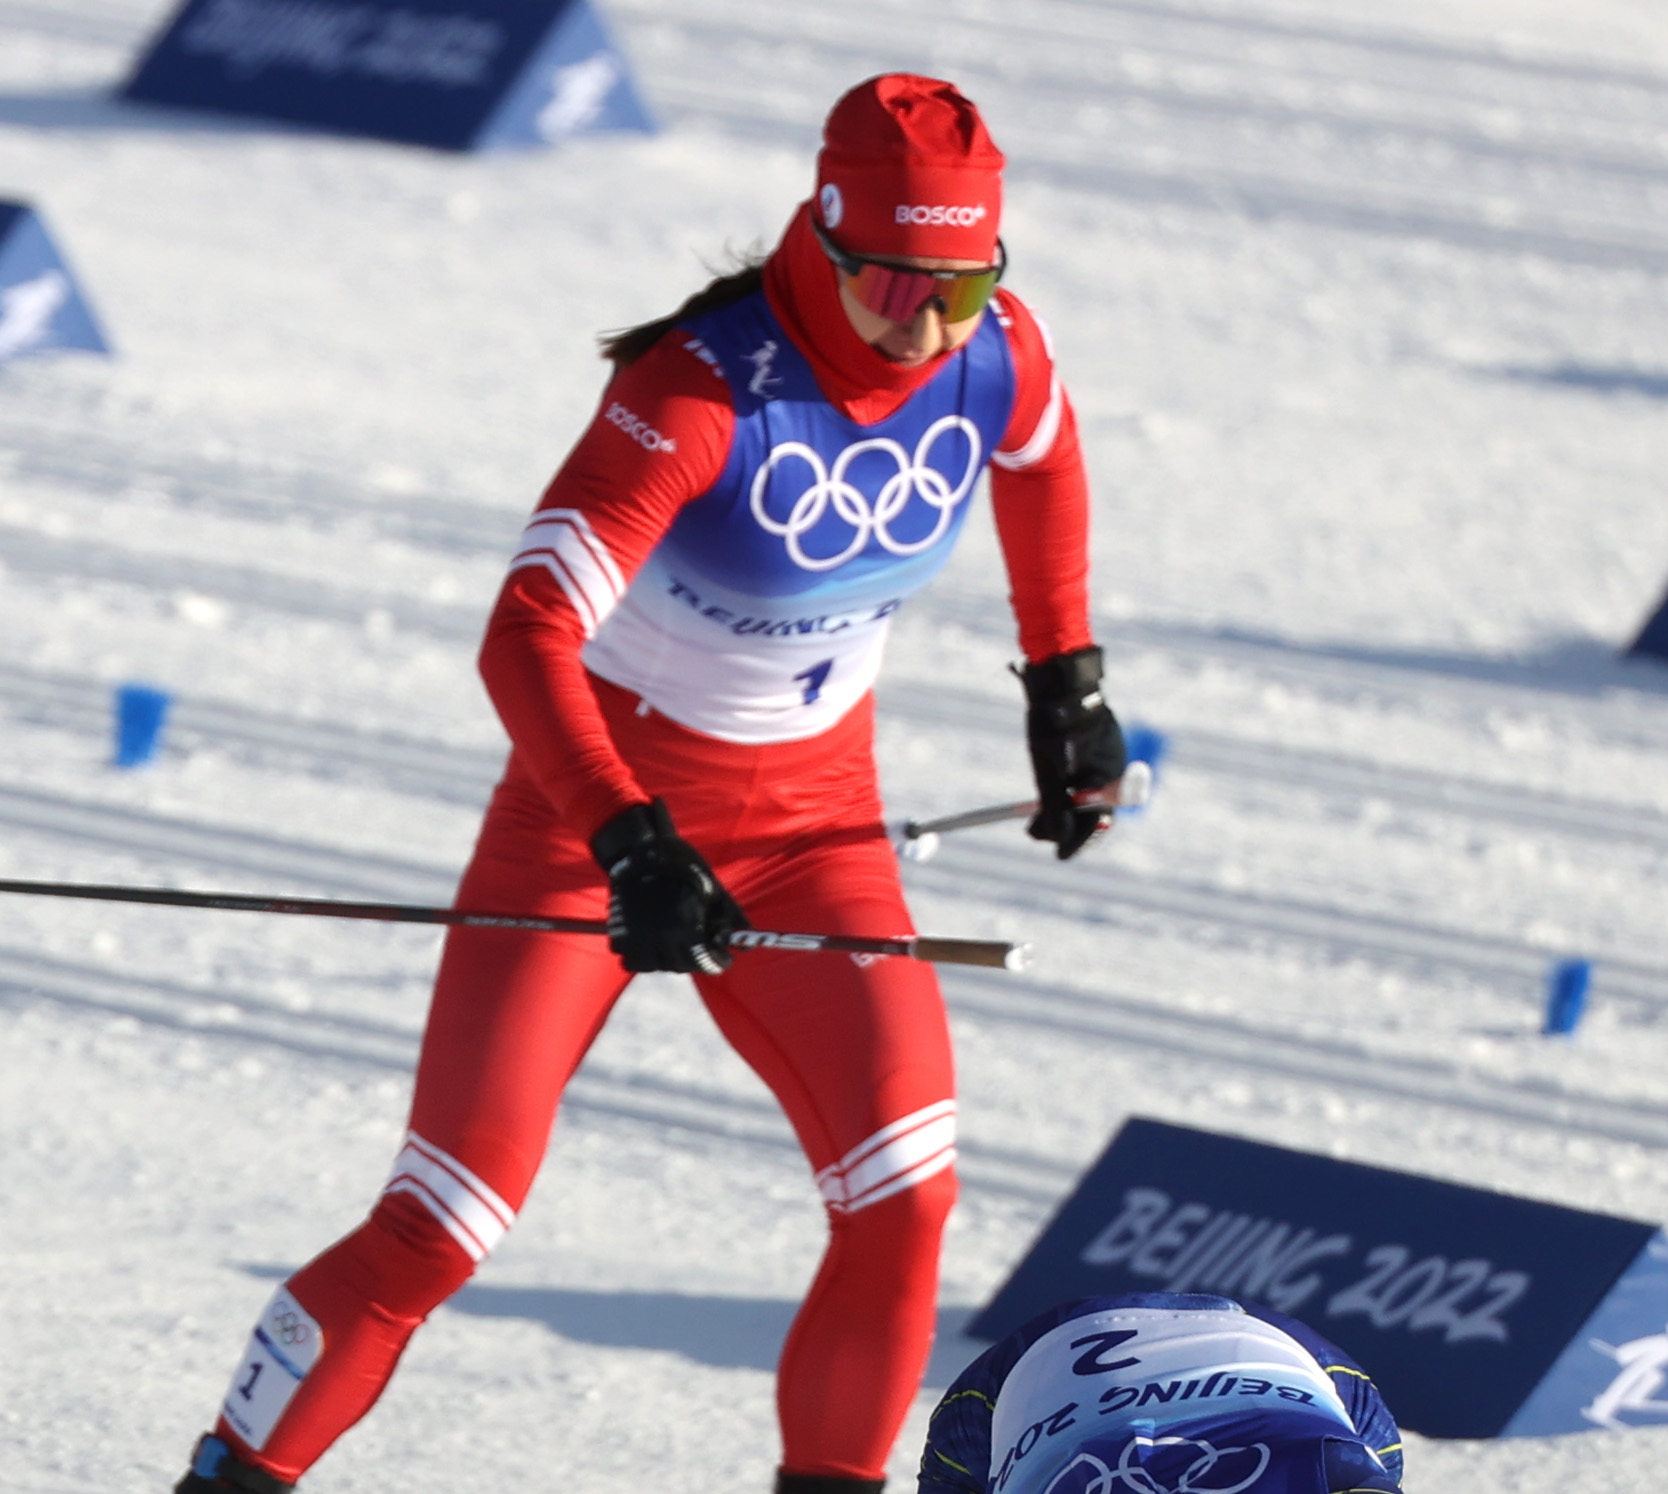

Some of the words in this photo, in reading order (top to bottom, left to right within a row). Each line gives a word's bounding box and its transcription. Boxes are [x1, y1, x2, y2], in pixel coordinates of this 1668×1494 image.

[895, 204, 977, 226] BOSCO
[793, 658, 834, 706] 1
[1081, 1187, 1352, 1313] BEIJING
[1326, 1243, 1530, 1343] 2022
[1069, 1329, 1143, 1377] 2
[238, 1362, 264, 1402] 1
[1098, 1371, 1320, 1416] BEIJING
